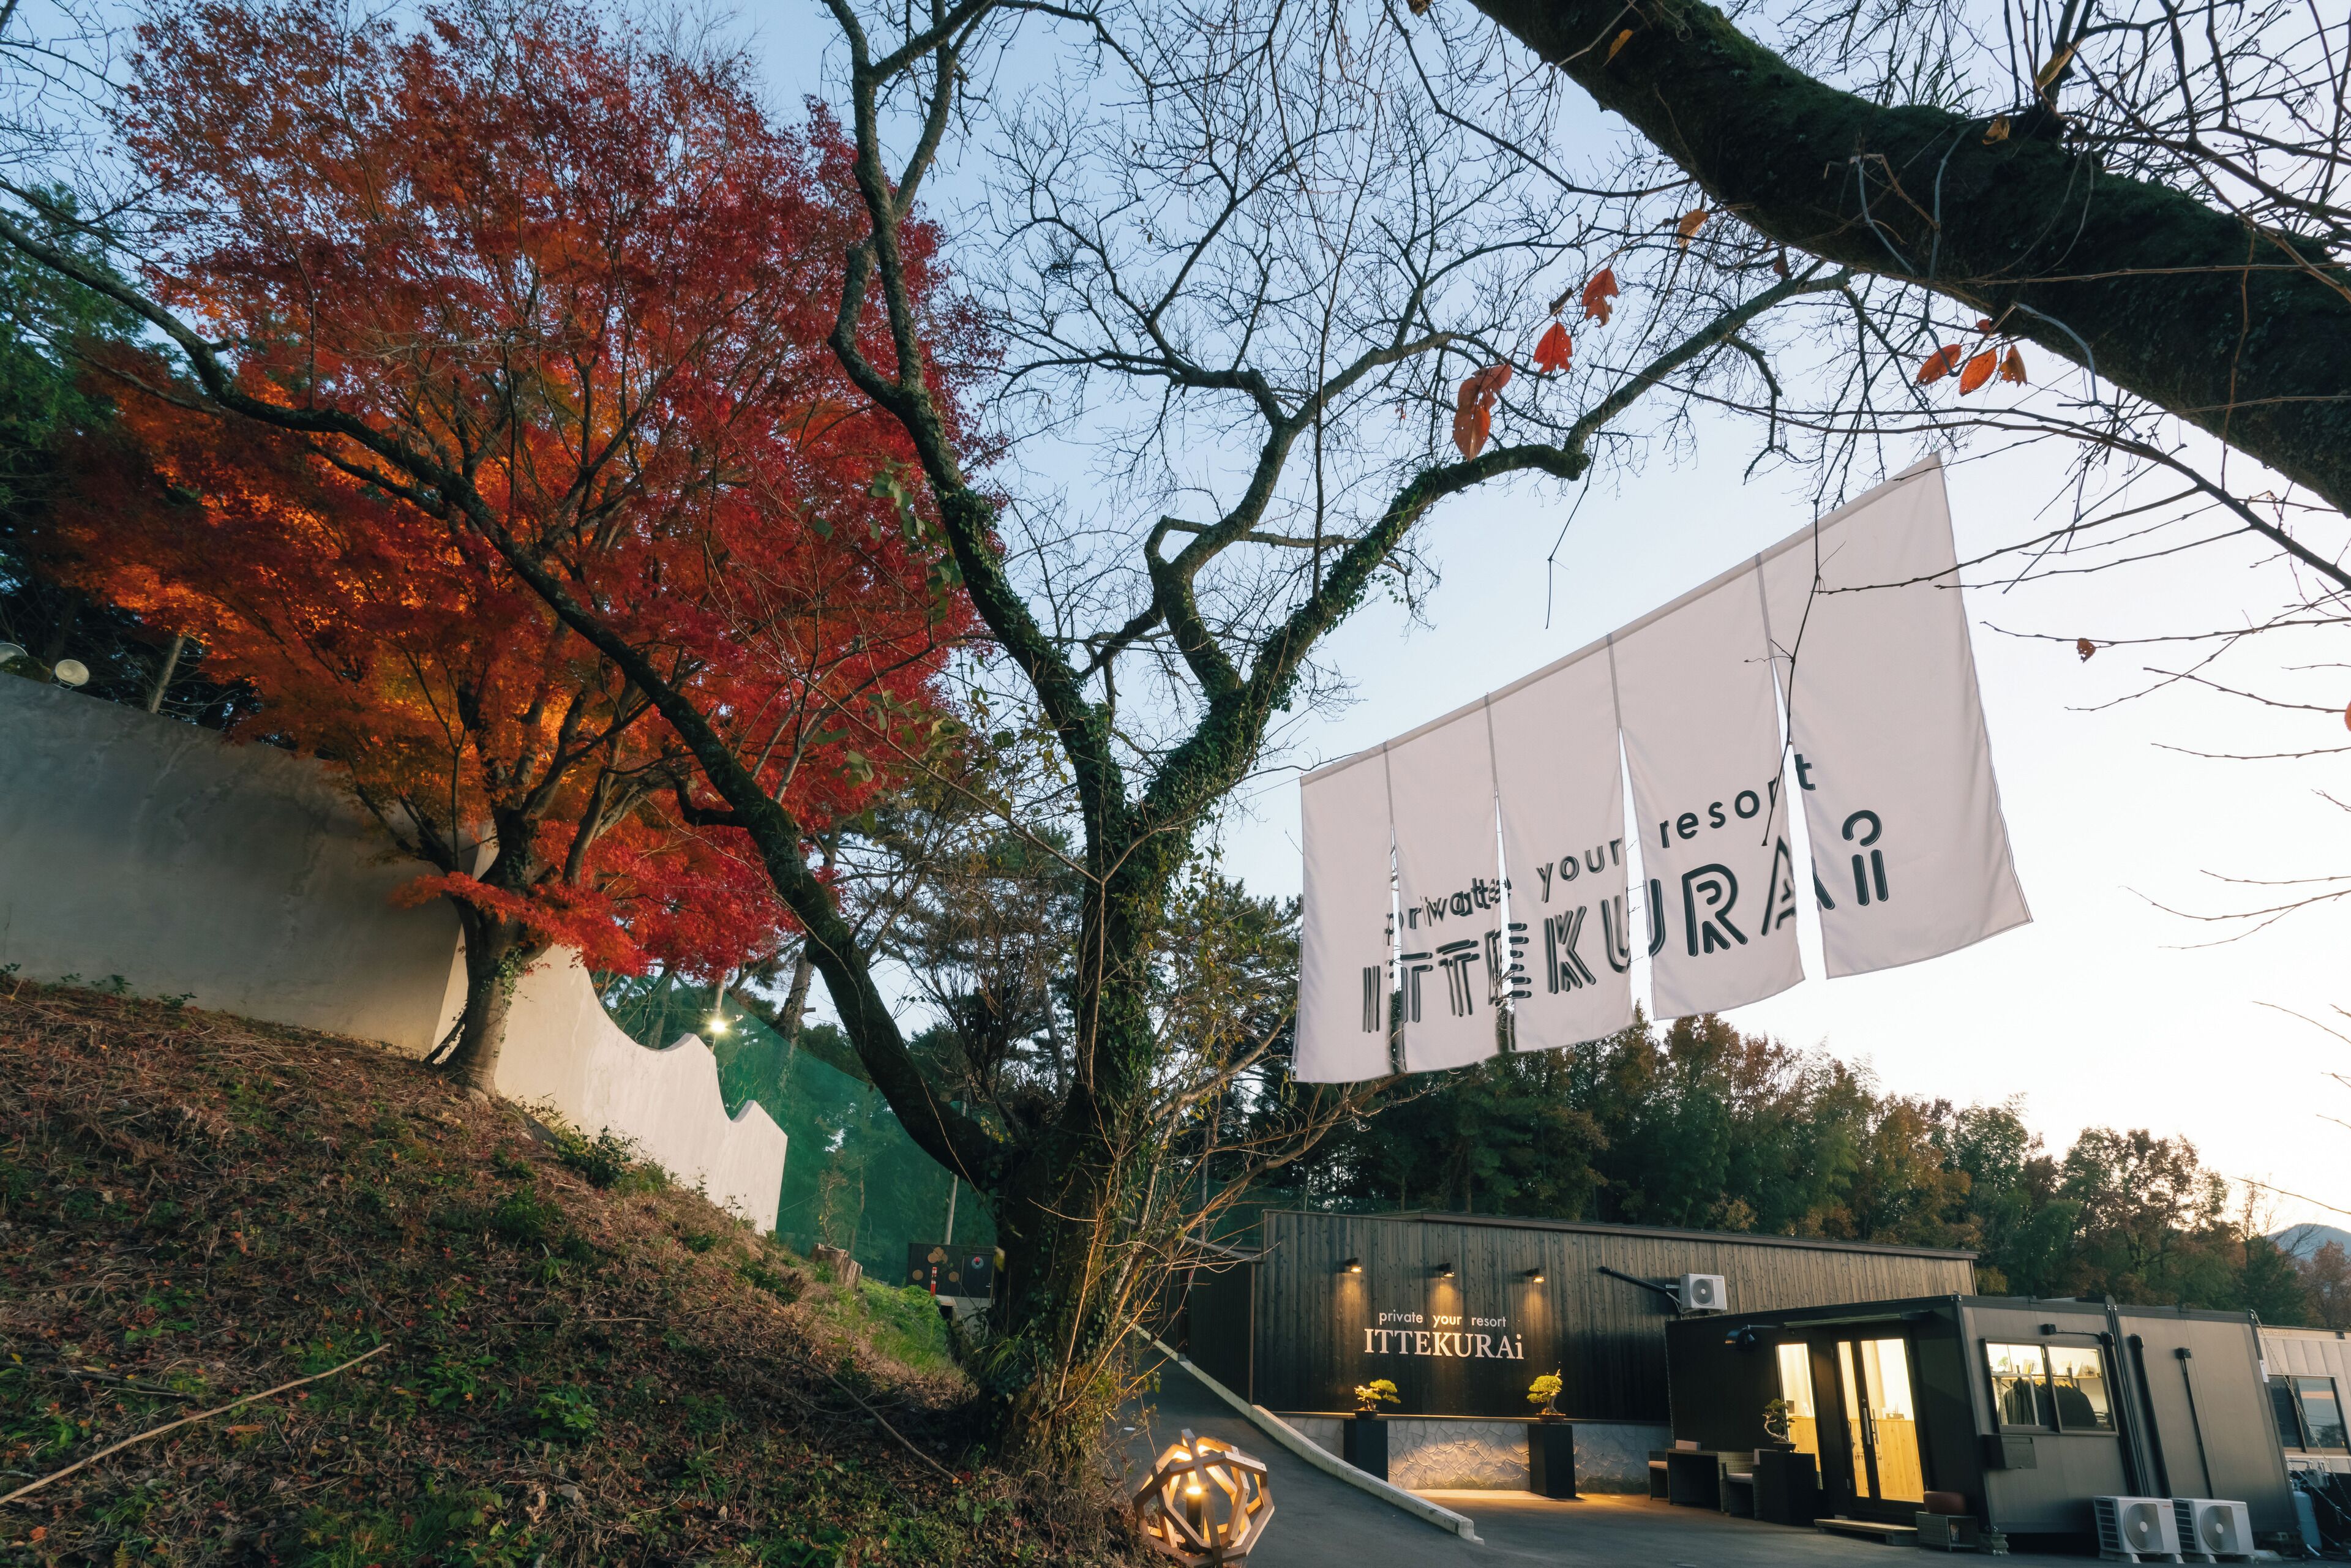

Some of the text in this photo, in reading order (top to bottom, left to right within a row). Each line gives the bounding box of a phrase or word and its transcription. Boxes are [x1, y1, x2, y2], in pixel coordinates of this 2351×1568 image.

[1536, 837, 1623, 903] your
[1659, 753, 1816, 849] resort
[1379, 1310, 1506, 1327] private your resort
[1364, 1328, 1524, 1359] ITTEKURAi
